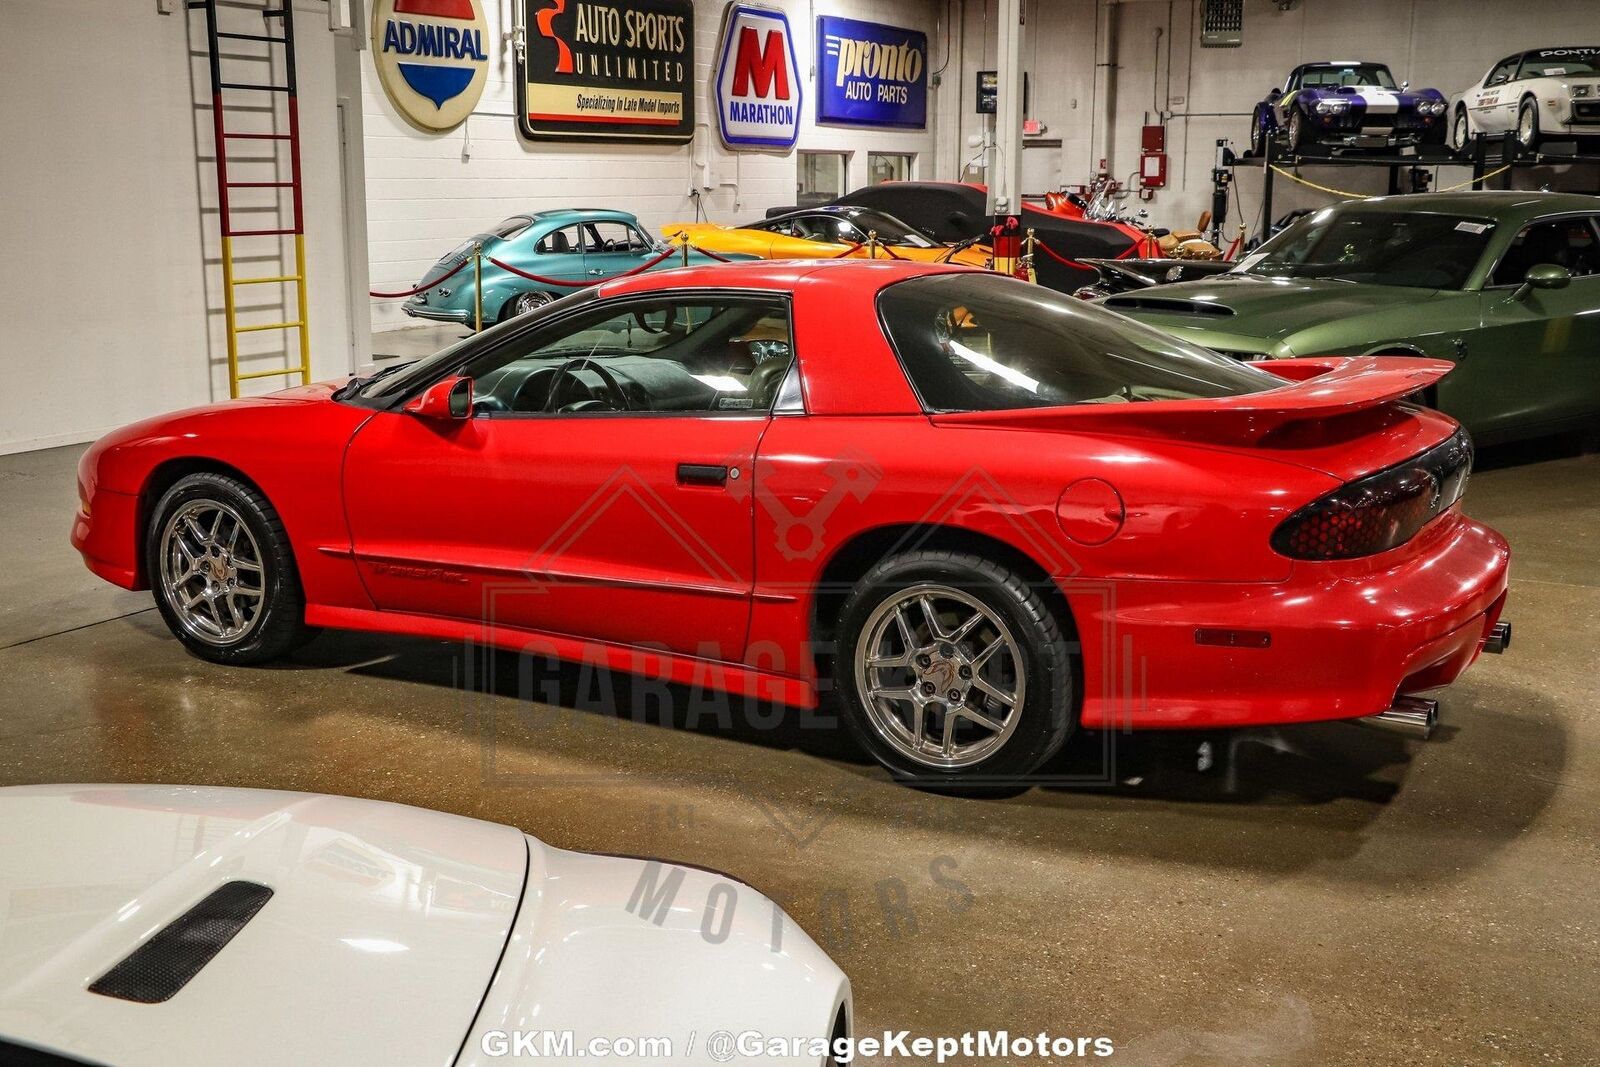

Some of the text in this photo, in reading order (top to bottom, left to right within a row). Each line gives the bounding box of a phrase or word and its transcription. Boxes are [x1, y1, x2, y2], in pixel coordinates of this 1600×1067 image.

[383, 19, 488, 61] ADMIRAL
[576, 3, 685, 54] AUTO SPORTS
[576, 52, 684, 83] UNLIMITED
[731, 25, 791, 101] M
[835, 35, 923, 87] pronto
[576, 93, 680, 114] Specializing In Late Model Imports
[845, 81, 908, 105] AUTO PARTS
[729, 100, 794, 126] MARATHON
